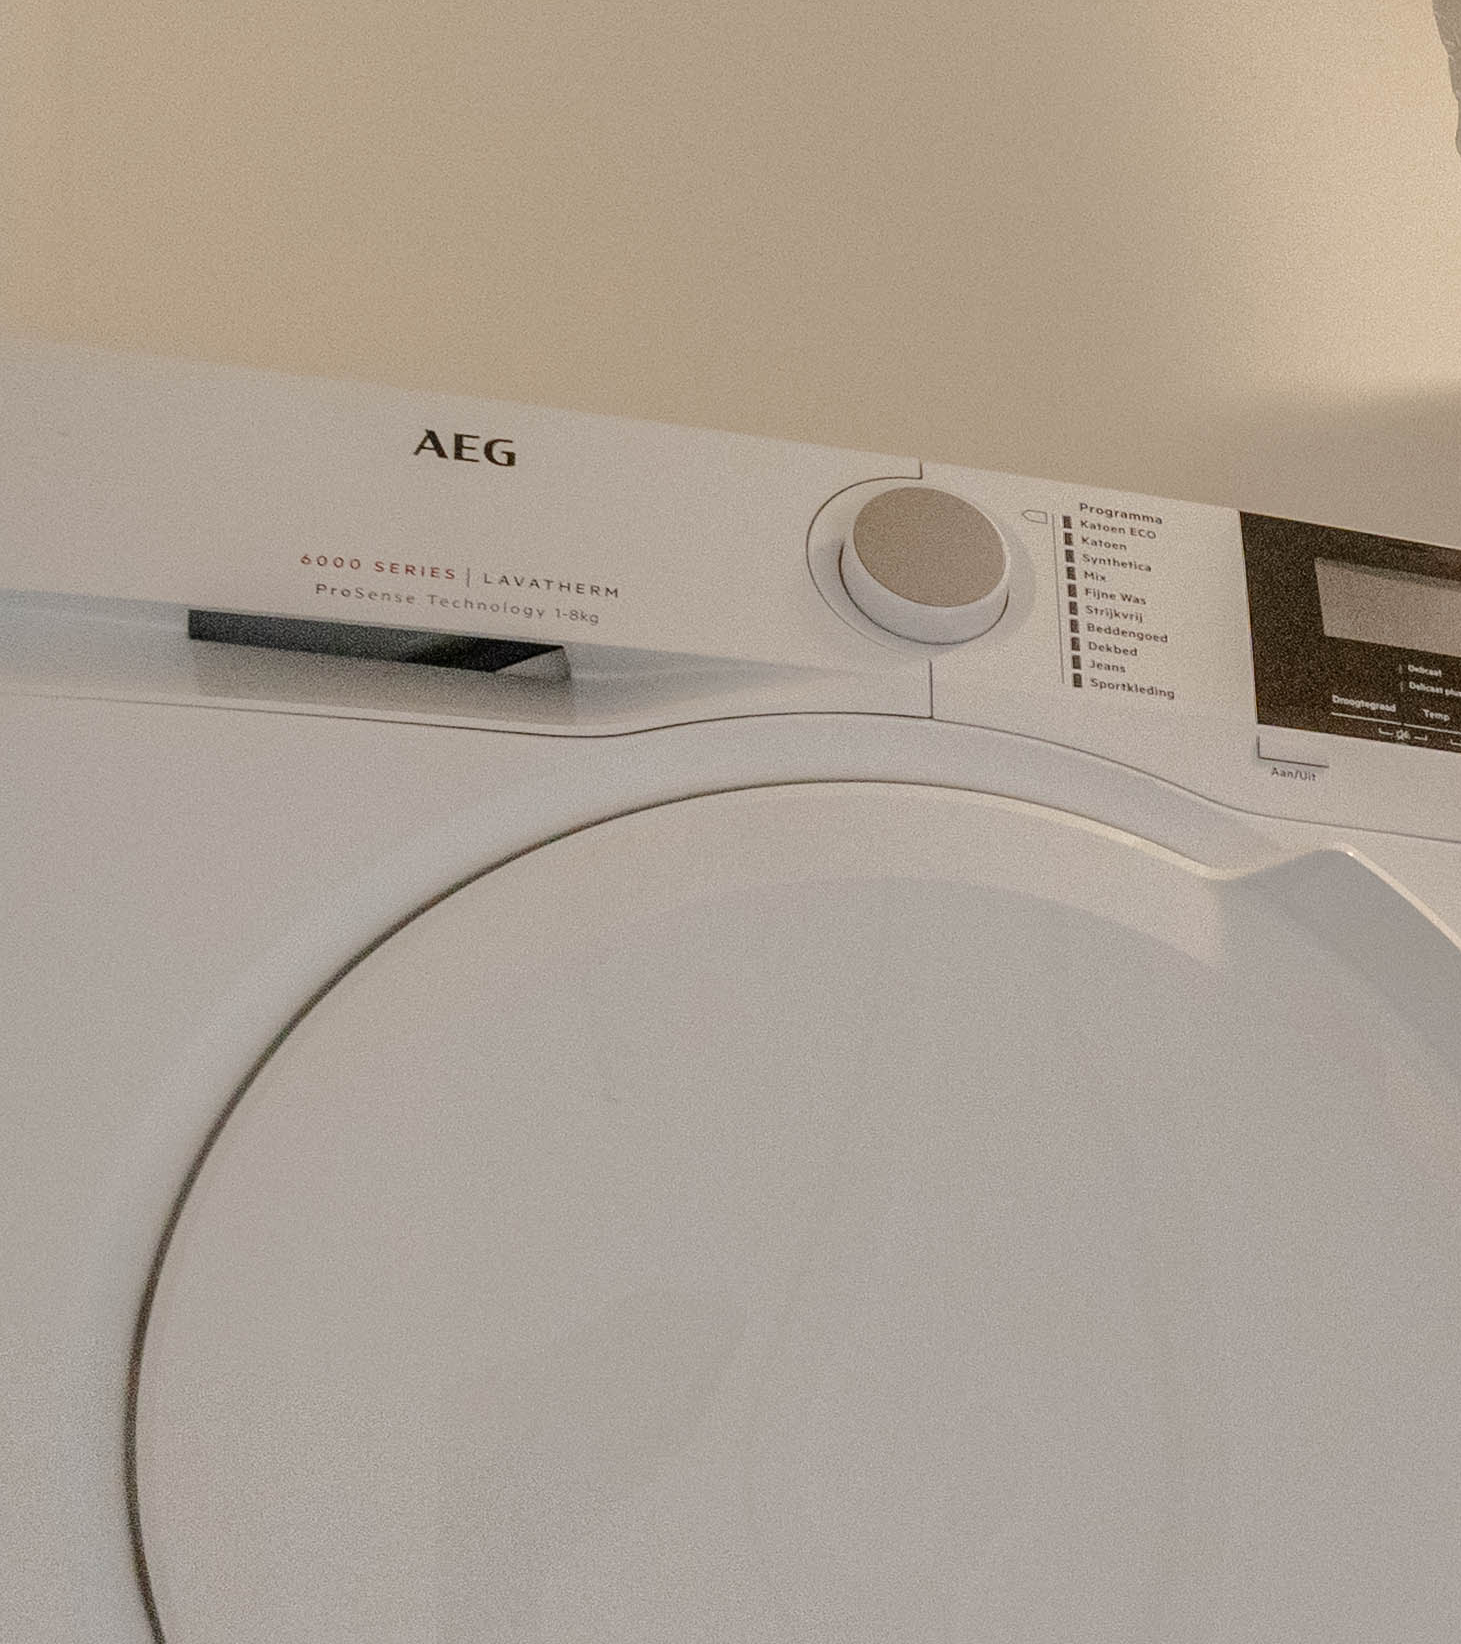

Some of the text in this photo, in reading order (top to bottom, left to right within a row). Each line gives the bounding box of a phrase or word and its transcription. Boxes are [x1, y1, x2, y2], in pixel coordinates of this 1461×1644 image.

[413, 429, 516, 467] AEG
[1079, 502, 1163, 525] Programma
[1080, 520, 1157, 539] Katoen ECO
[1081, 537, 1128, 551] Katoen
[1082, 554, 1152, 572] Synthetica
[300, 553, 619, 598] 6000 SERIES LAVATHERM
[1084, 571, 1106, 582] Mix
[315, 583, 600, 626] ProSense Technology 1-8kg
[1084, 587, 1146, 605] Fijne Was
[1086, 606, 1143, 623] Strijkvrij
[1087, 623, 1168, 643] Beddengoed
[1088, 642, 1138, 656] Dekbed
[1089, 660, 1126, 673] Jeans
[1090, 678, 1175, 700] Sportkleding
[1271, 767, 1316, 782] Aan/Uit
